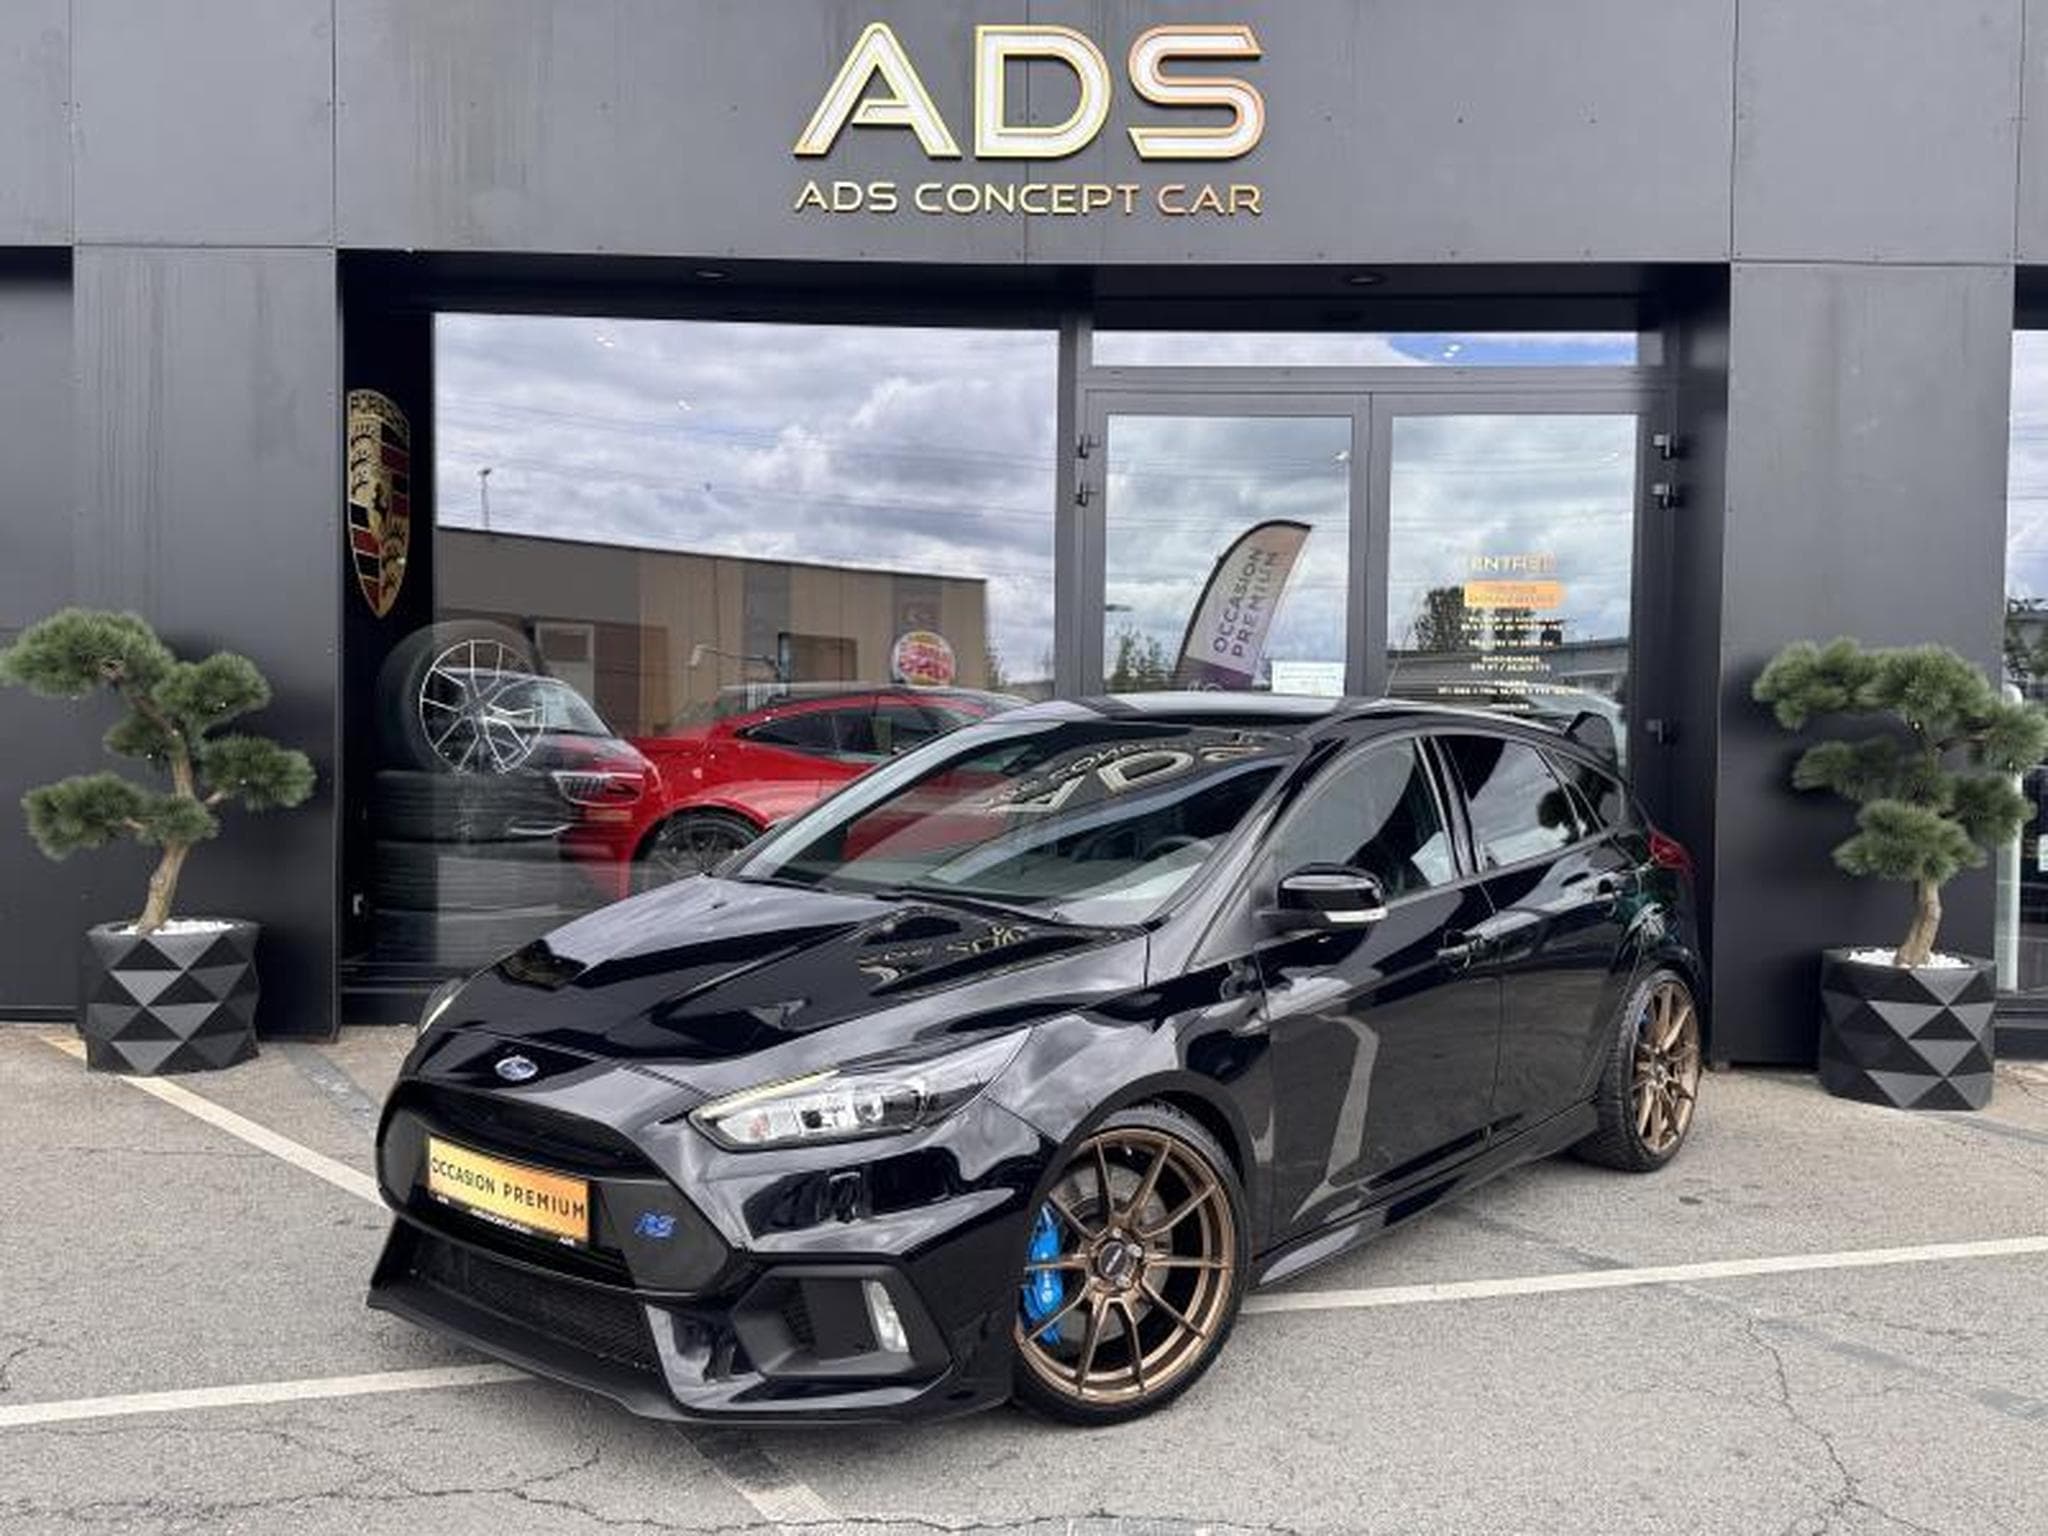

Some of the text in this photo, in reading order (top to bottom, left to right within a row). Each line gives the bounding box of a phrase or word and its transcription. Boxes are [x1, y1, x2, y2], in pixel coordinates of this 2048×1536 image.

[793, 21, 1267, 160] ADS
[794, 180, 1263, 216] ADS CONCEPT CAR
[1212, 547, 1264, 654] OCCASION
[1231, 551, 1279, 657] PREMIUM
[431, 1156, 586, 1220] OCCASION PREMIUM
